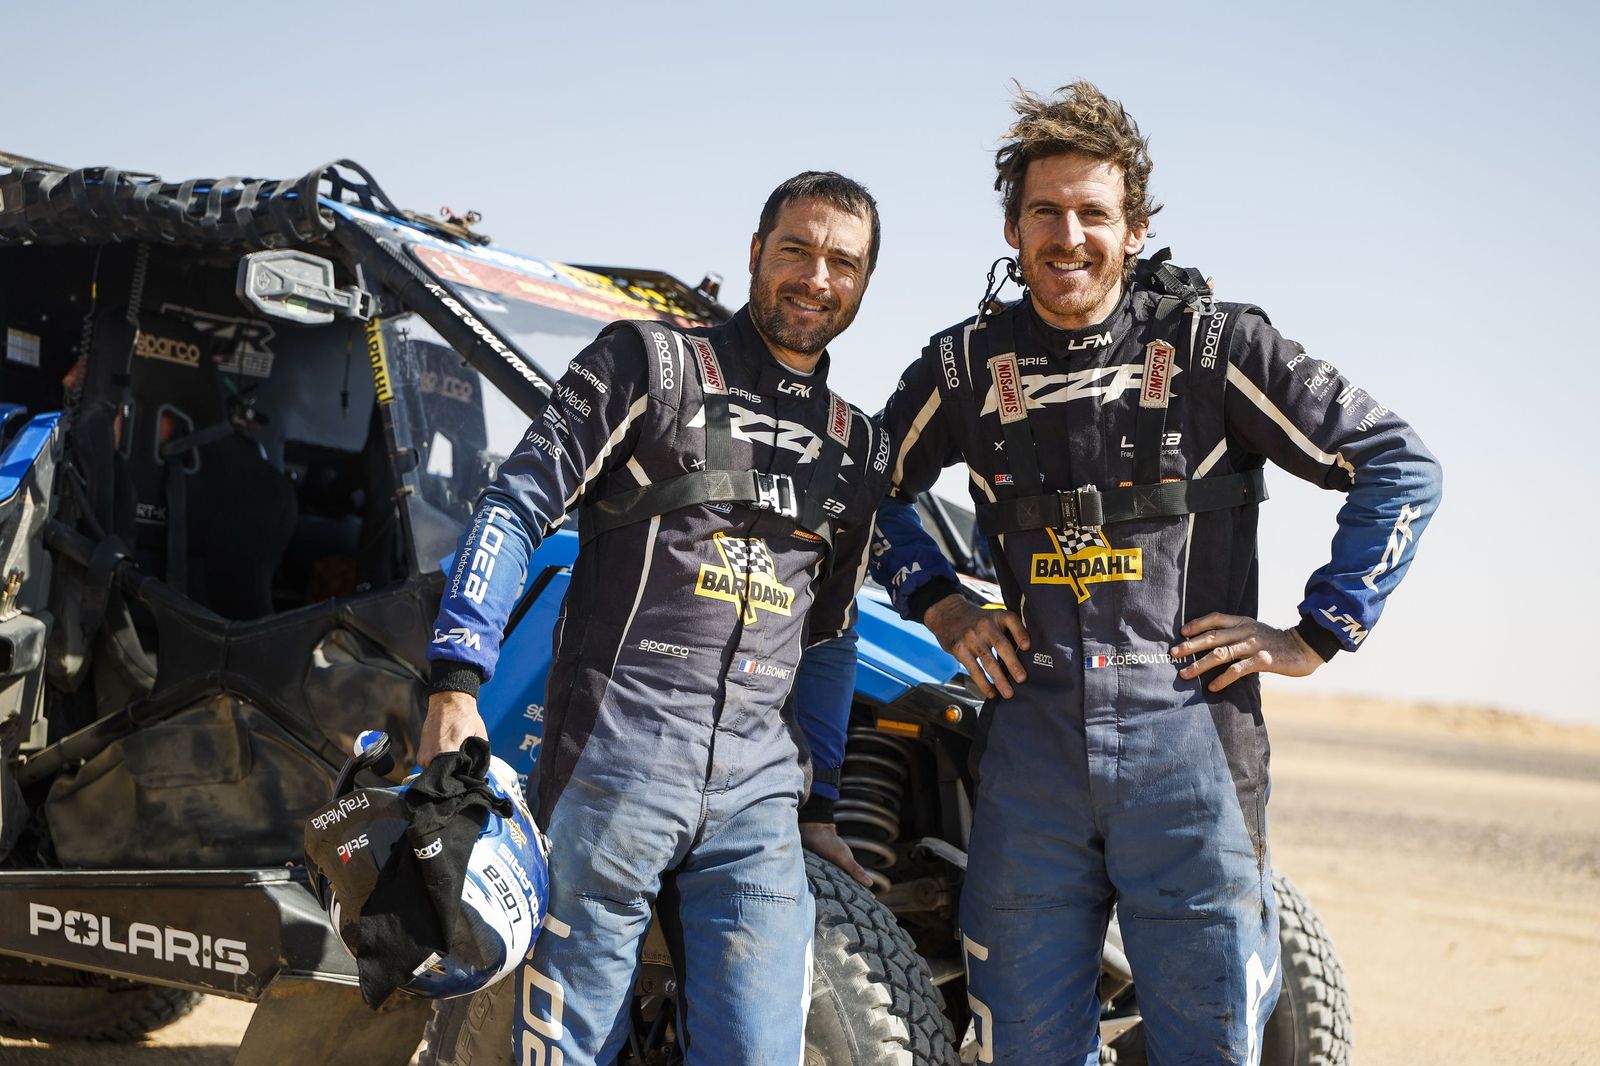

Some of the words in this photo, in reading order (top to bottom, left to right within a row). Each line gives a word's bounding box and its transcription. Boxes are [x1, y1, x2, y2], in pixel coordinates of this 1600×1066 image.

[651, 331, 674, 390] sparco
[697, 341, 720, 388] SIMPSON
[939, 335, 960, 390] sparco
[1200, 311, 1229, 370] sparco
[728, 386, 762, 404] ARIS
[998, 362, 1018, 414] SIMPSON
[1148, 348, 1168, 400] SIMPSON
[832, 398, 849, 438] SIMPSON
[449, 547, 471, 600] Motorsport
[463, 505, 512, 605] LOEB
[1034, 555, 1137, 579] BARDAHL
[701, 569, 790, 611] BARDAHL
[638, 638, 690, 659] sparco
[754, 662, 792, 681] M.BONNET
[310, 792, 371, 831] FrayMédia
[482, 864, 522, 924] LOEB
[498, 842, 541, 930] POLARIS
[29, 902, 250, 976] POLARIS
